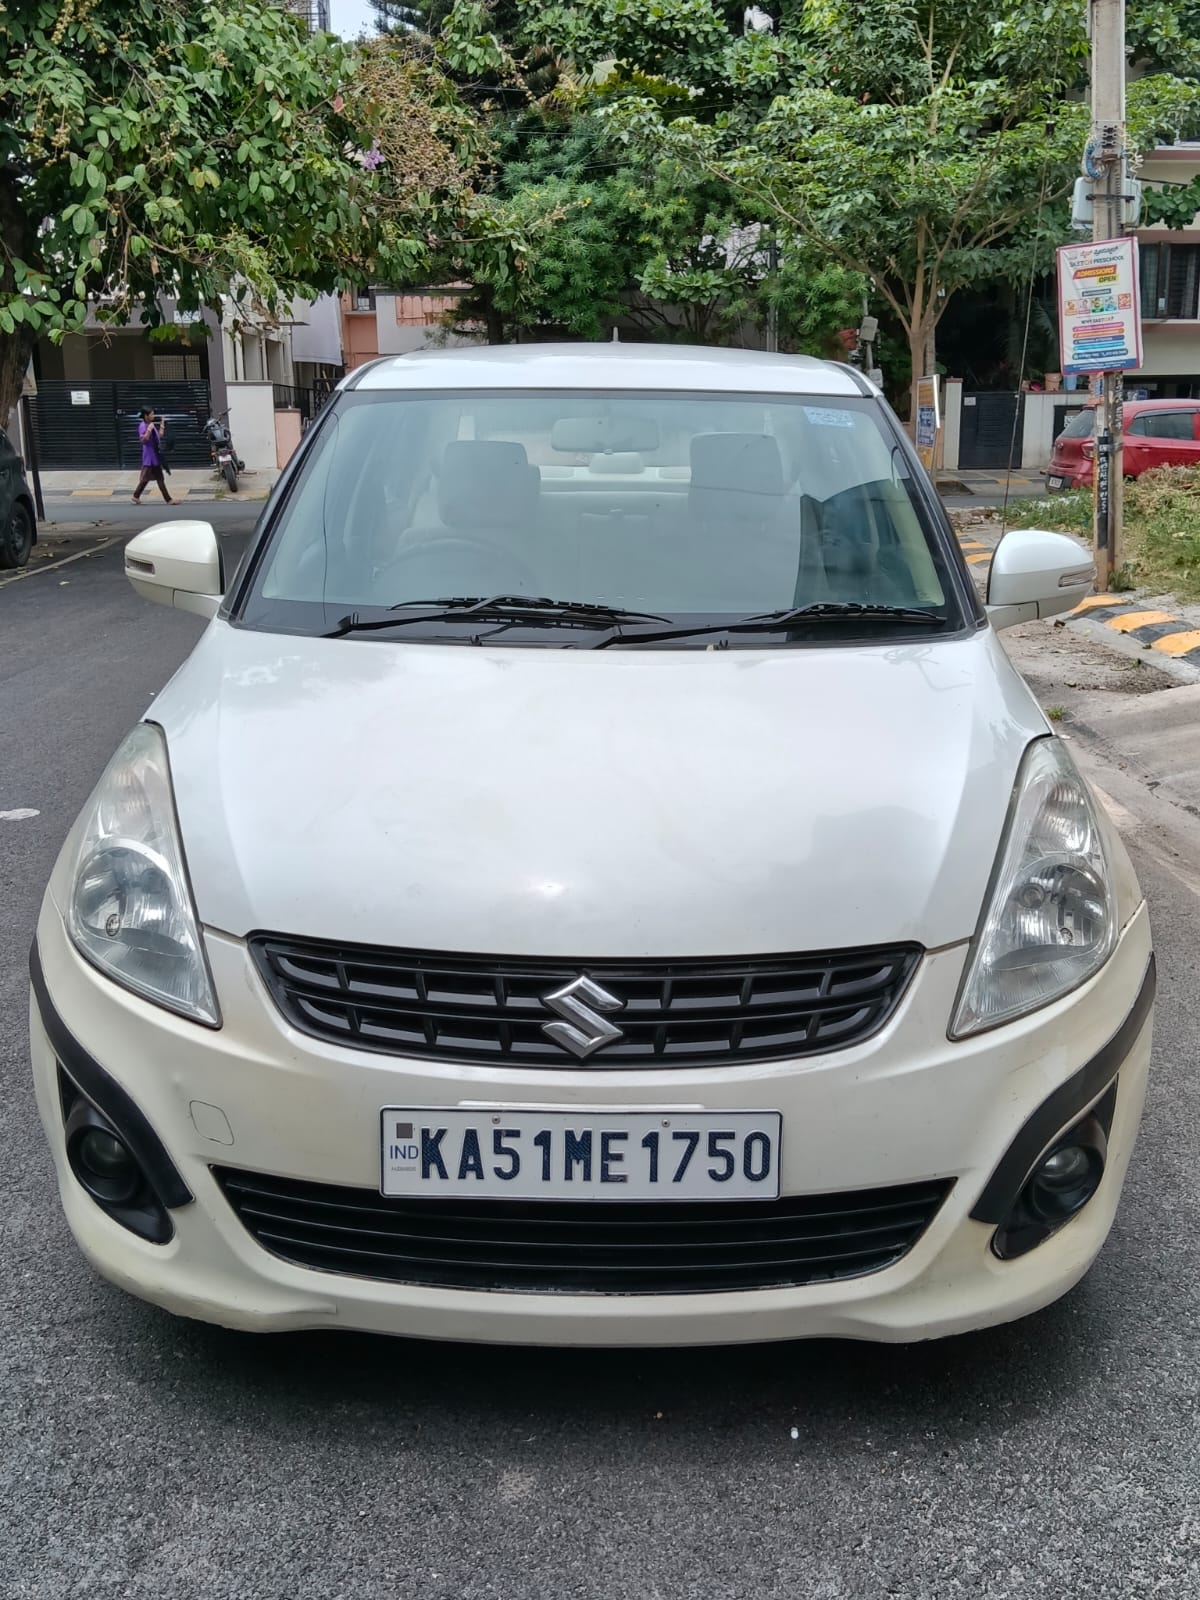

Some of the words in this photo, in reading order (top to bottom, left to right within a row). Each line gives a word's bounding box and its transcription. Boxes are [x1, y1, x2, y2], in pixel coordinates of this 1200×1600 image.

[1094, 256, 1124, 264] PRESCHOOL
[1077, 268, 1114, 278] ADMISSIONS
[390, 1145, 419, 1160] IND
[421, 1127, 771, 1184] KA51ME1750
